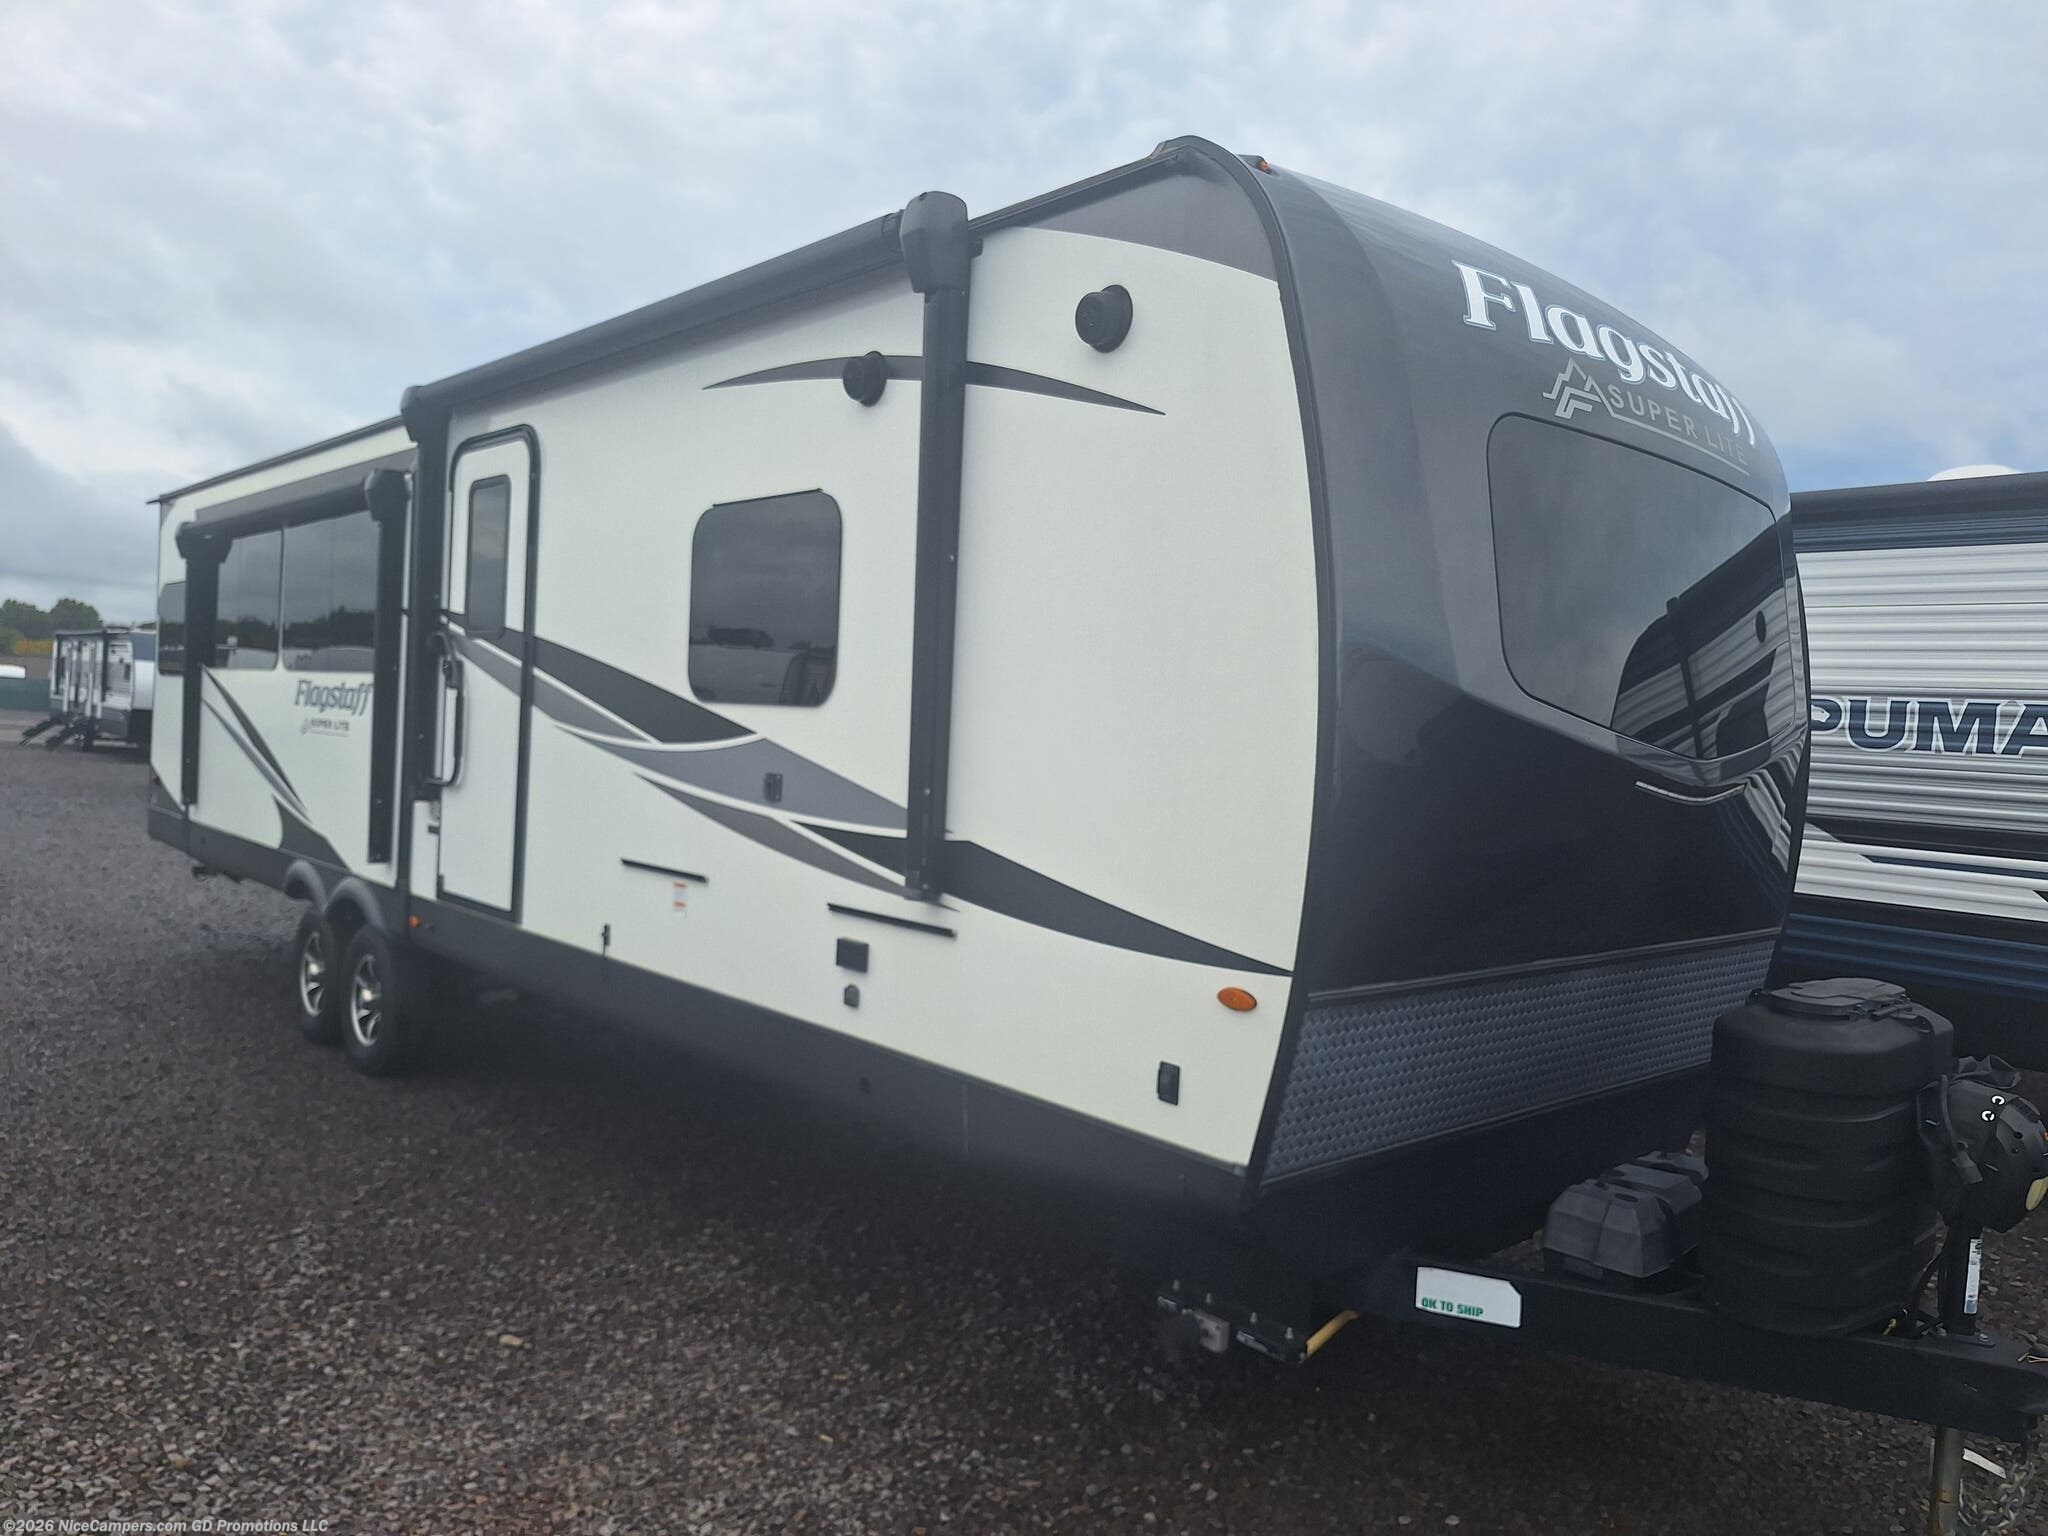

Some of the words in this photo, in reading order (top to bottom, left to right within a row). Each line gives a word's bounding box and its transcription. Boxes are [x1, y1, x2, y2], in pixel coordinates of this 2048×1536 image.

[1451, 259, 1756, 449] Flagstaff
[1607, 384, 1698, 440] SUPER
[1703, 424, 1748, 466] LITE
[294, 679, 374, 716] Flagstaff
[1811, 696, 2048, 758] PUMA
[1421, 1297, 1437, 1309] OK
[1440, 1300, 1454, 1312] TO
[1457, 1303, 1484, 1317] SHIP
